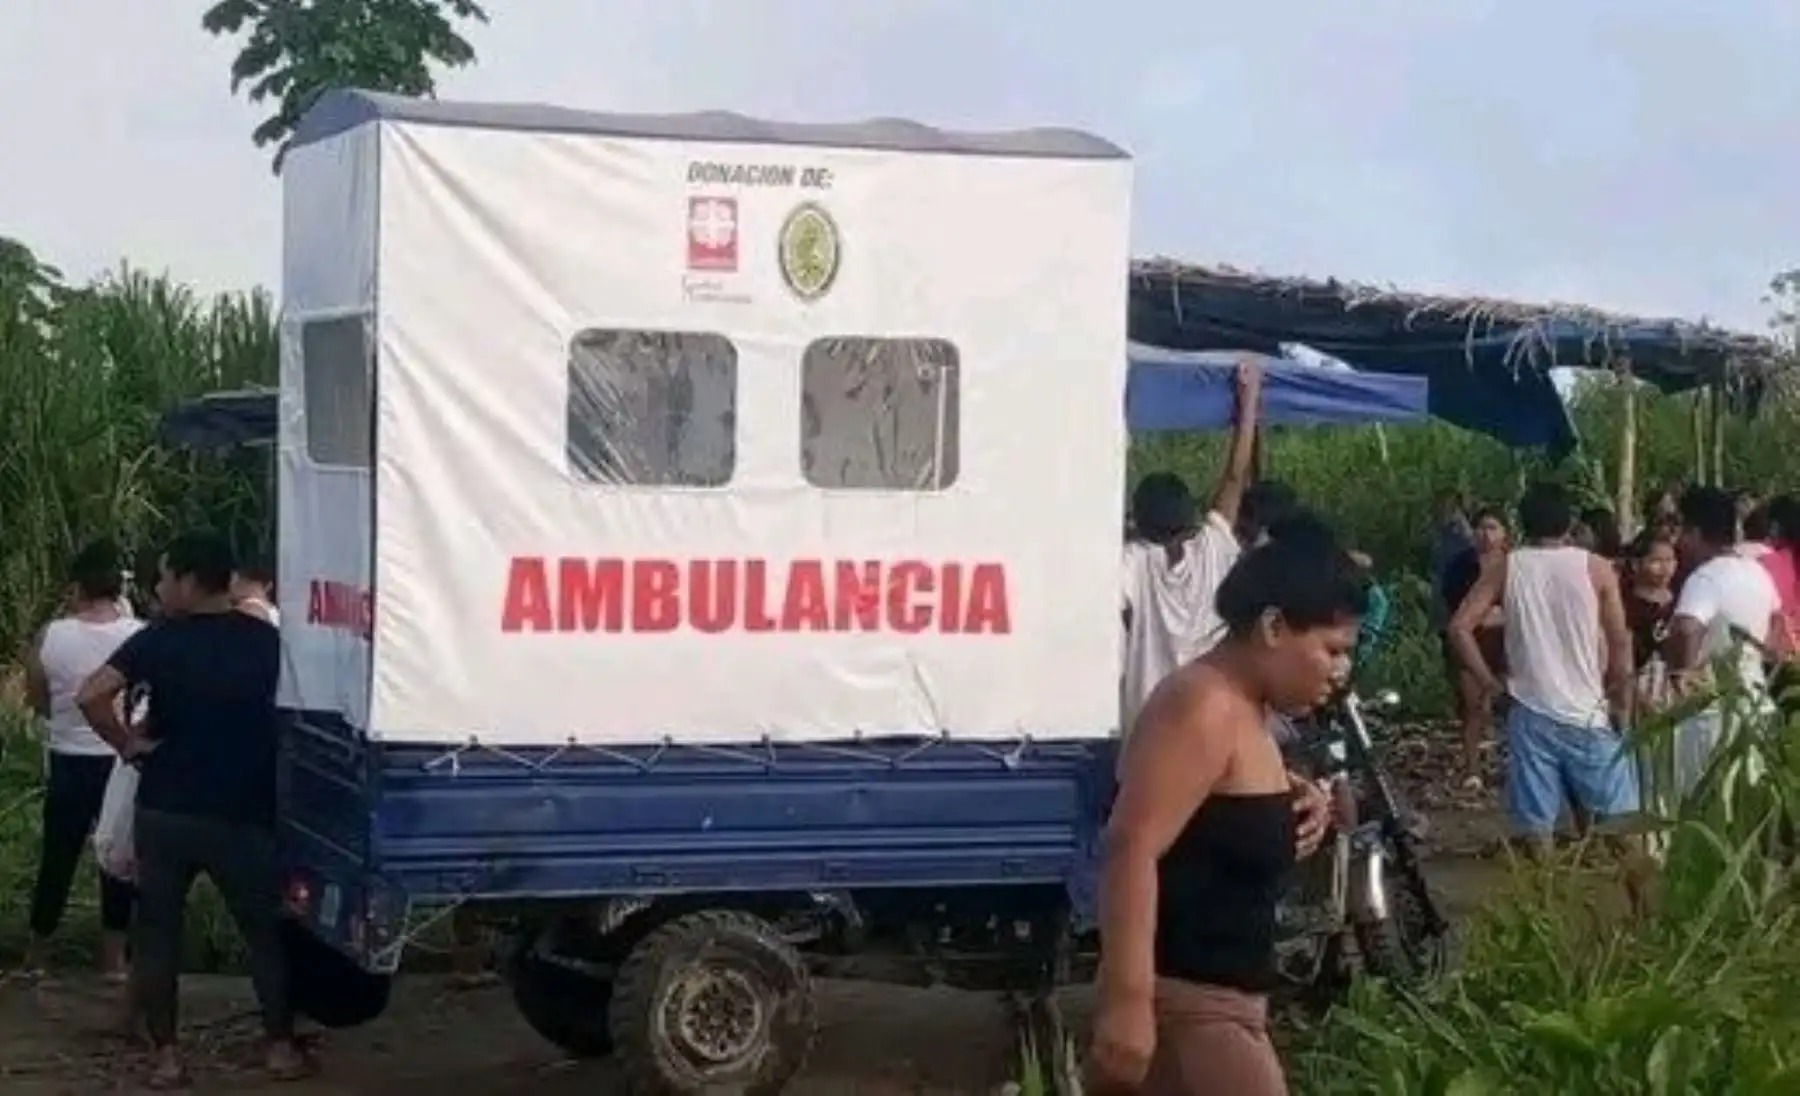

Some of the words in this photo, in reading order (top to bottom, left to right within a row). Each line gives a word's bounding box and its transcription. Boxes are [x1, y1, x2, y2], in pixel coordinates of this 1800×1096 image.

[687, 162, 796, 186] DONACION
[800, 168, 834, 188] DE:
[501, 556, 1012, 635] AMBULANCIA
